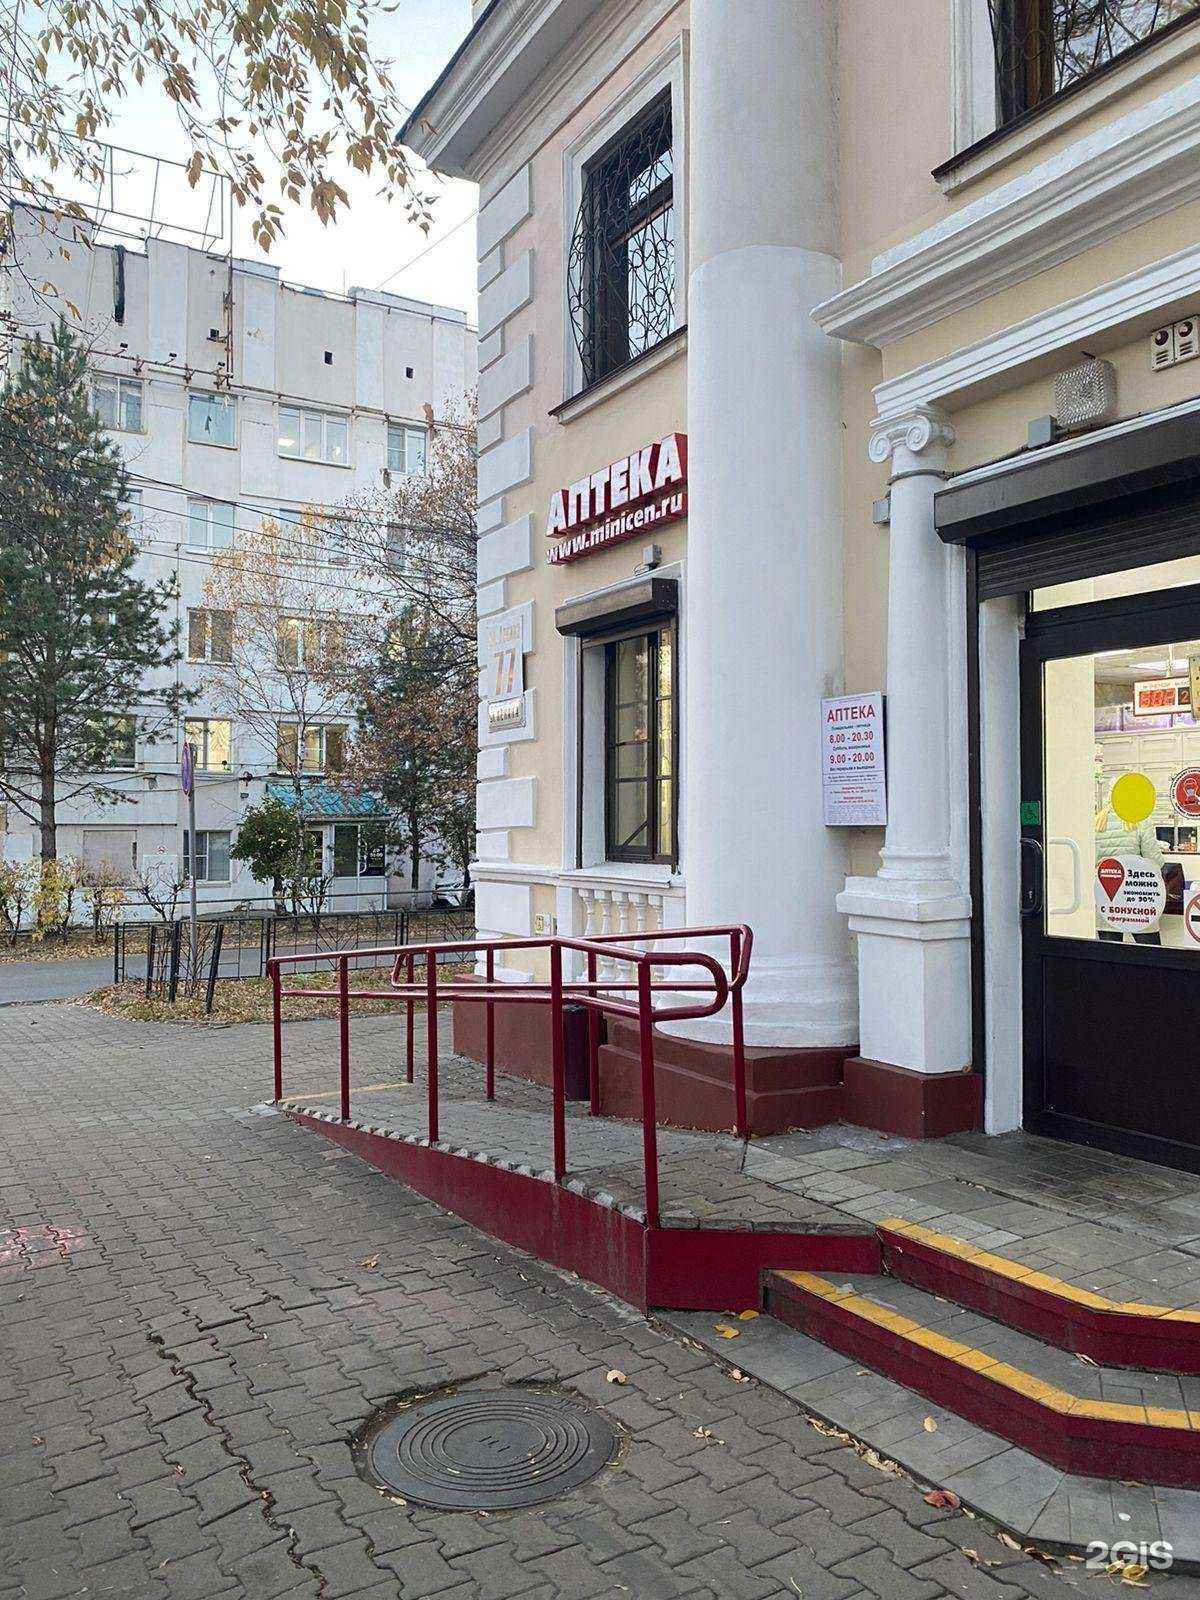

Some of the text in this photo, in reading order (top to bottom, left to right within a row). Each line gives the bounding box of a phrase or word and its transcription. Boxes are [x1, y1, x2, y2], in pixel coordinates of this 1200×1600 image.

[546, 433, 687, 537] АПТЕКА
[547, 493, 687, 564] www.minicen.ru
[827, 704, 875, 723] АПТЕКА
[852, 731, 874, 742] 20.30
[829, 754, 846, 764] 9.00
[852, 752, 875, 763] 20.00
[1127, 869, 1156, 878] Здесь
